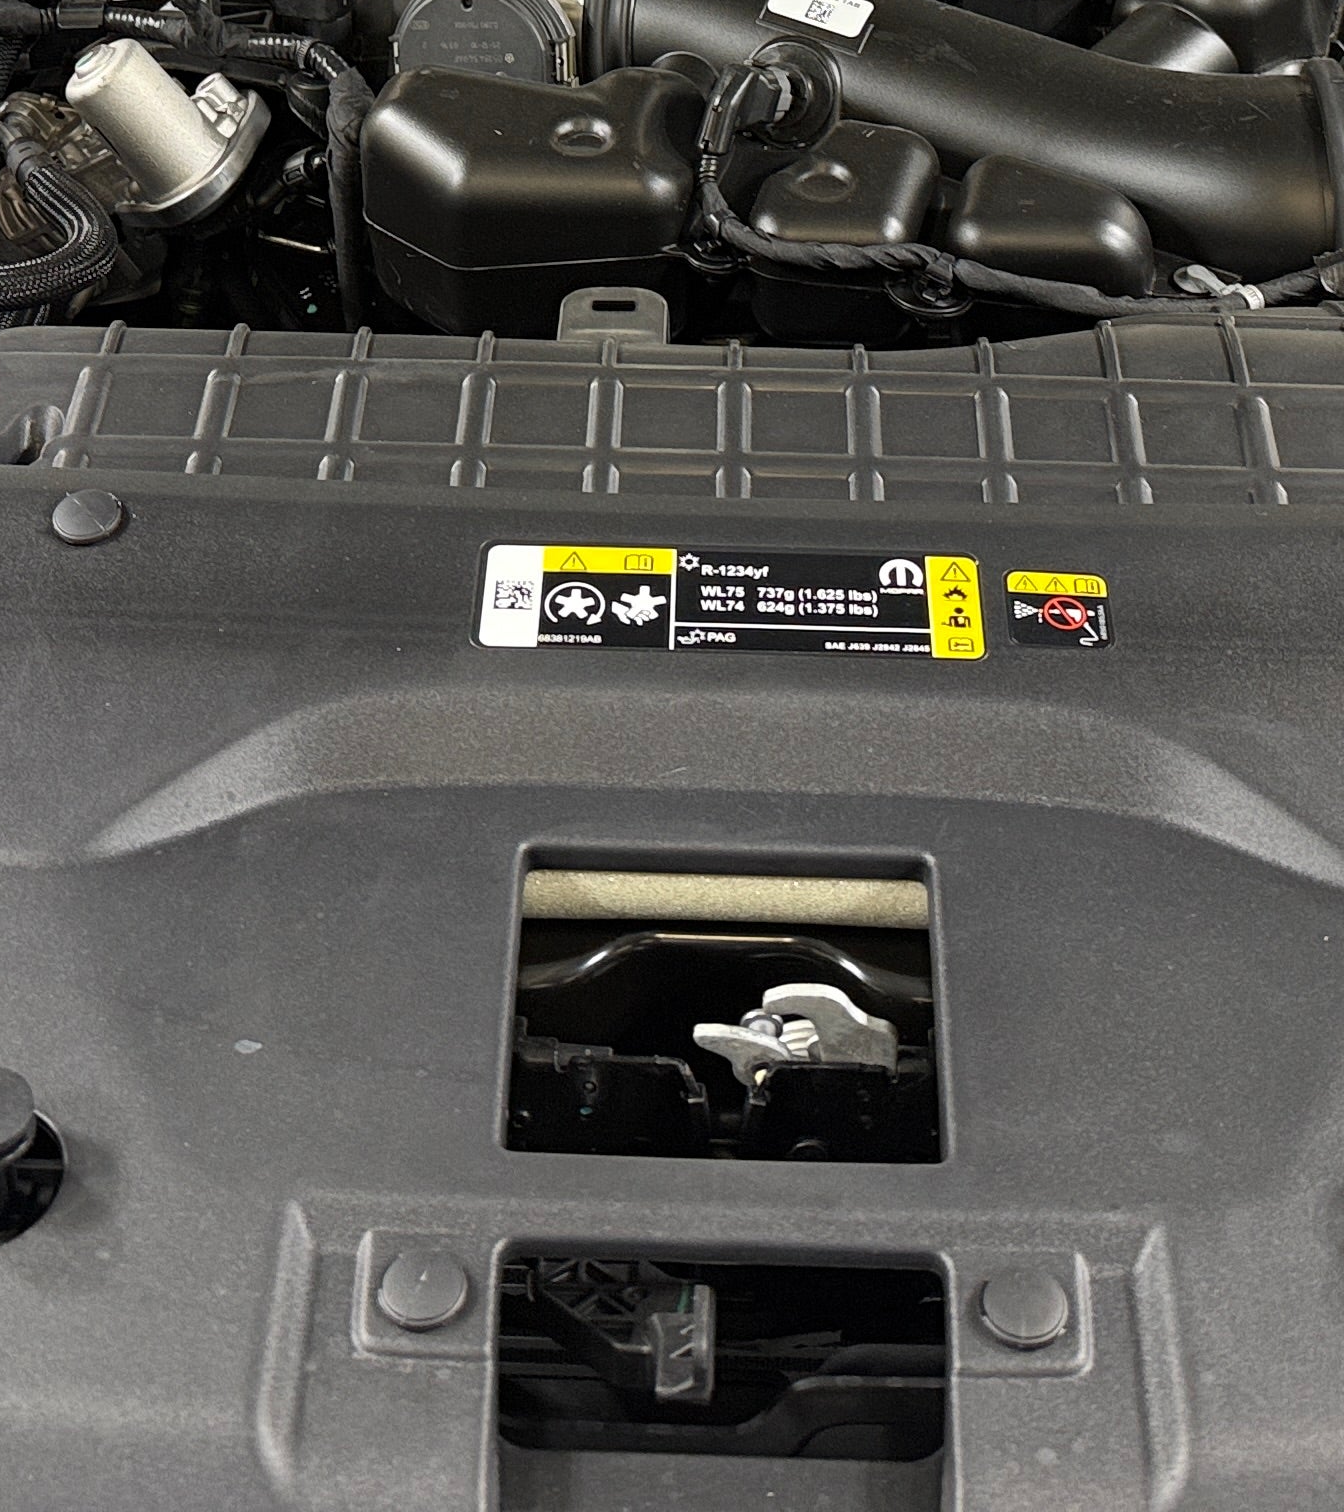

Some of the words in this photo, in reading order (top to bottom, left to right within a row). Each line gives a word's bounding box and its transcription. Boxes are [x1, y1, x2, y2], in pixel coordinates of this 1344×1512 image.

[700, 564, 769, 579] R-1234yf
[700, 585, 746, 598] WL75
[756, 586, 795, 602] 737g
[797, 587, 846, 602] (1.625
[848, 588, 879, 604] lbs)
[700, 599, 746, 612] WL74
[756, 600, 796, 617] 624g
[798, 601, 846, 617] (1.375
[848, 602, 879, 618] lbs)
[706, 632, 737, 643] PAG
[824, 641, 847, 651] SAE
